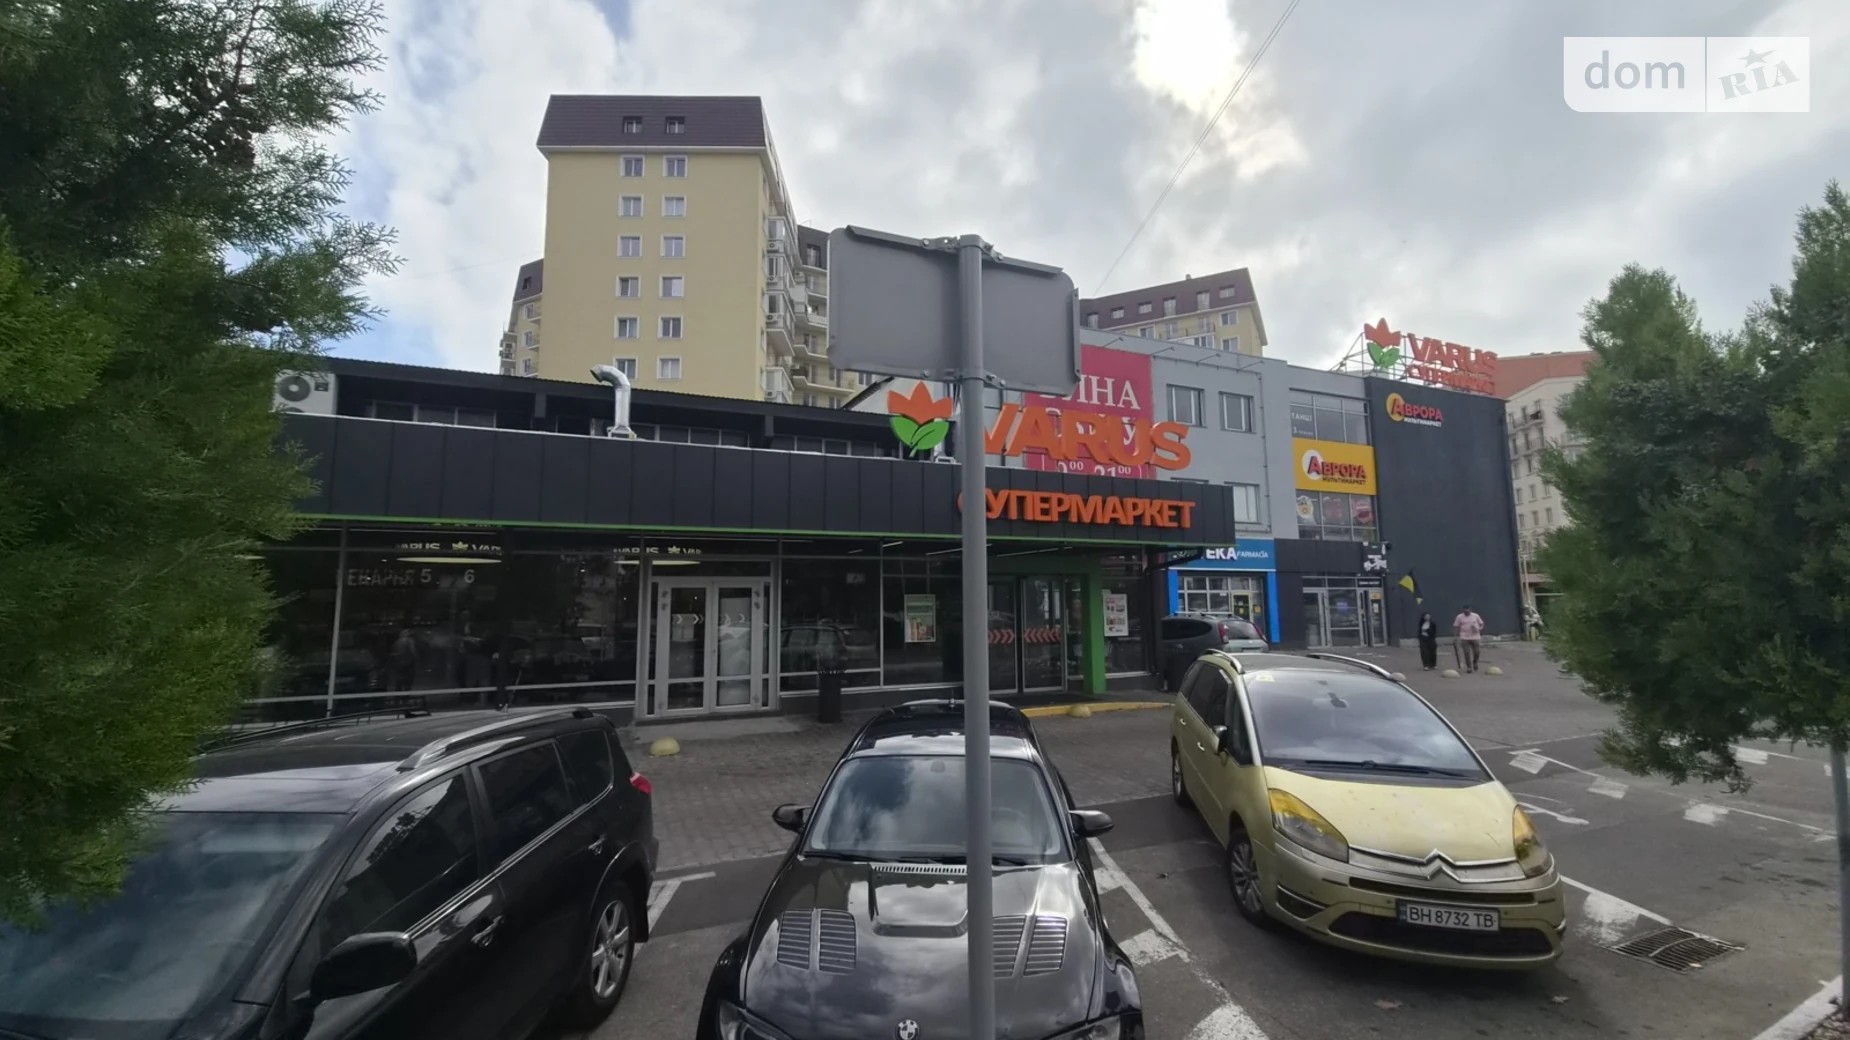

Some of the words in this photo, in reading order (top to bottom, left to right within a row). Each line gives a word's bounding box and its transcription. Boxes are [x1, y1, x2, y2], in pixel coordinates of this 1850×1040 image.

[1407, 332, 1499, 376] VARUS
[1391, 397, 1443, 421] АВРОРА
[984, 402, 1192, 471] VARUS
[1307, 455, 1367, 479] АВРОРА
[957, 488, 1196, 529] УПЕРМАРКЕТ
[1409, 906, 1432, 923] BH
[1434, 909, 1470, 927] 8732
[1473, 912, 1494, 928] TB
